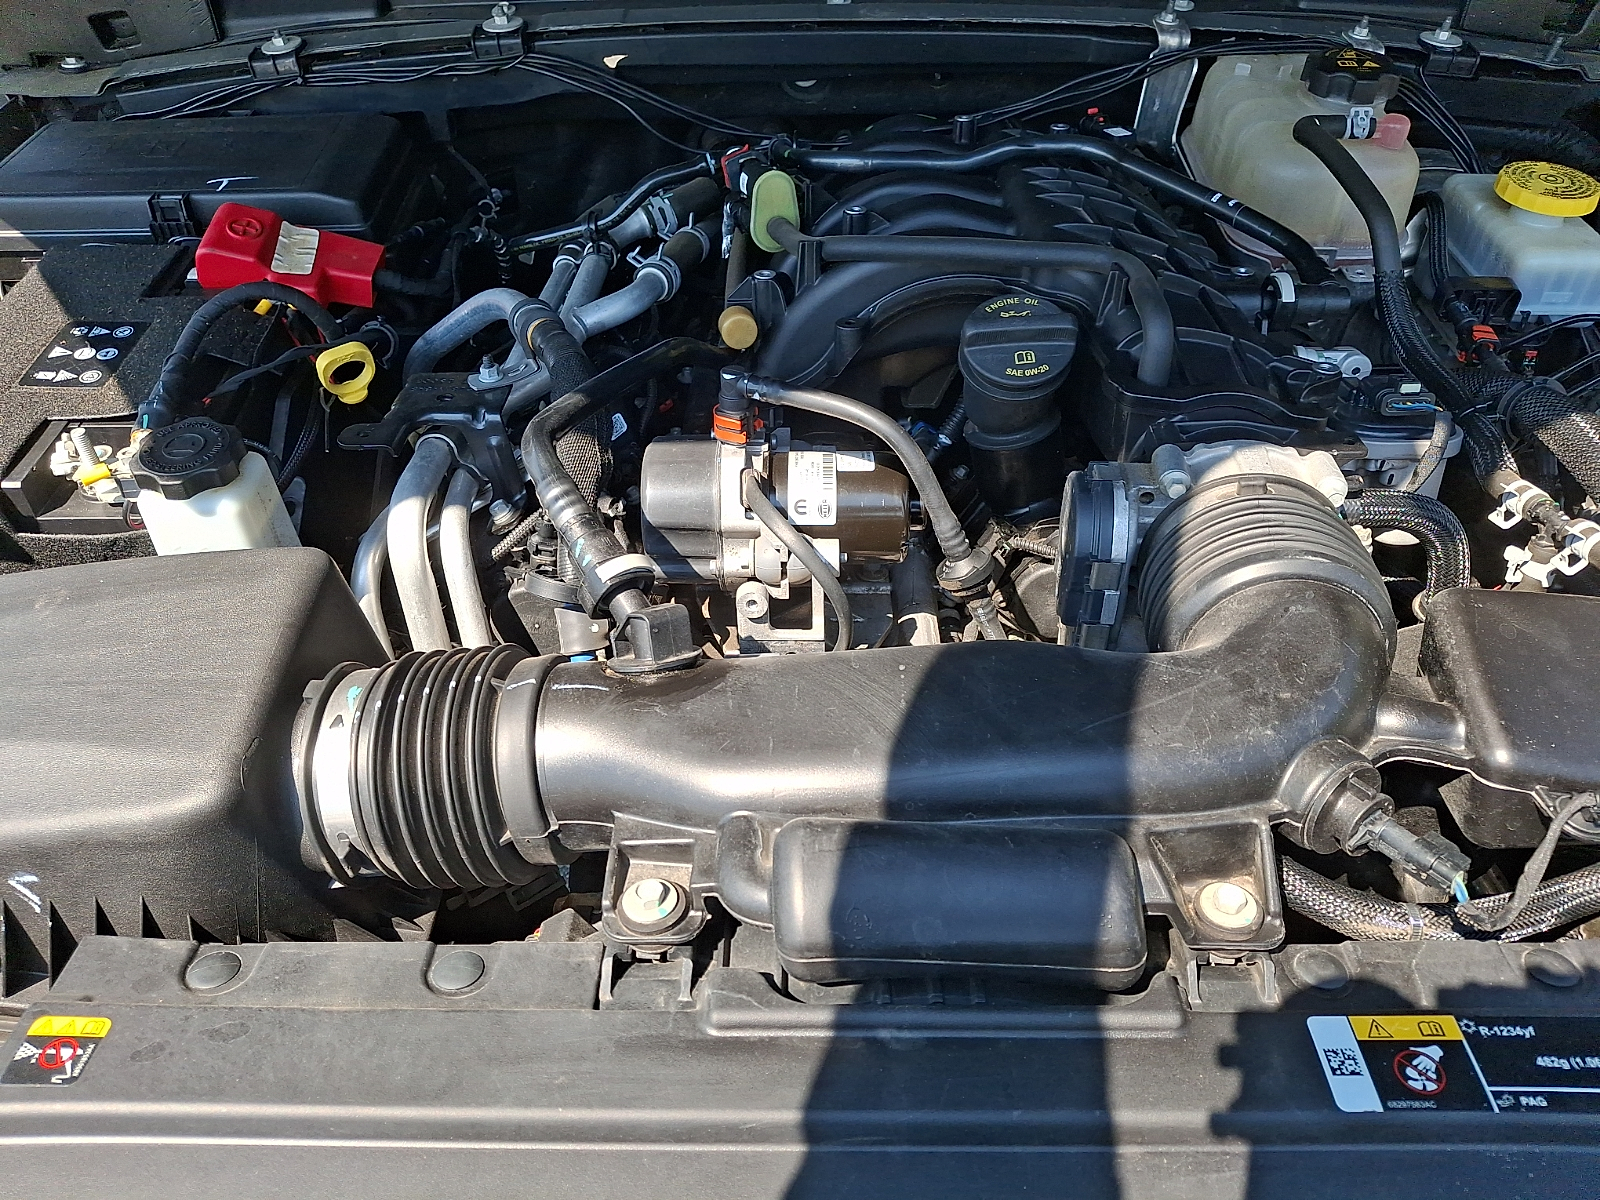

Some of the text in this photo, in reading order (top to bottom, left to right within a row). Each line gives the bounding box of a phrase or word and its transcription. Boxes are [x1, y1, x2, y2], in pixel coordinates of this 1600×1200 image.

[984, 297, 1040, 313] ENGINE OIL
[1005, 364, 1050, 377] SAE 0W-20
[177, 420, 223, 436] APPROVED
[1478, 1025, 1536, 1039] R-1234yf
[1519, 1095, 1548, 1107] PAG
